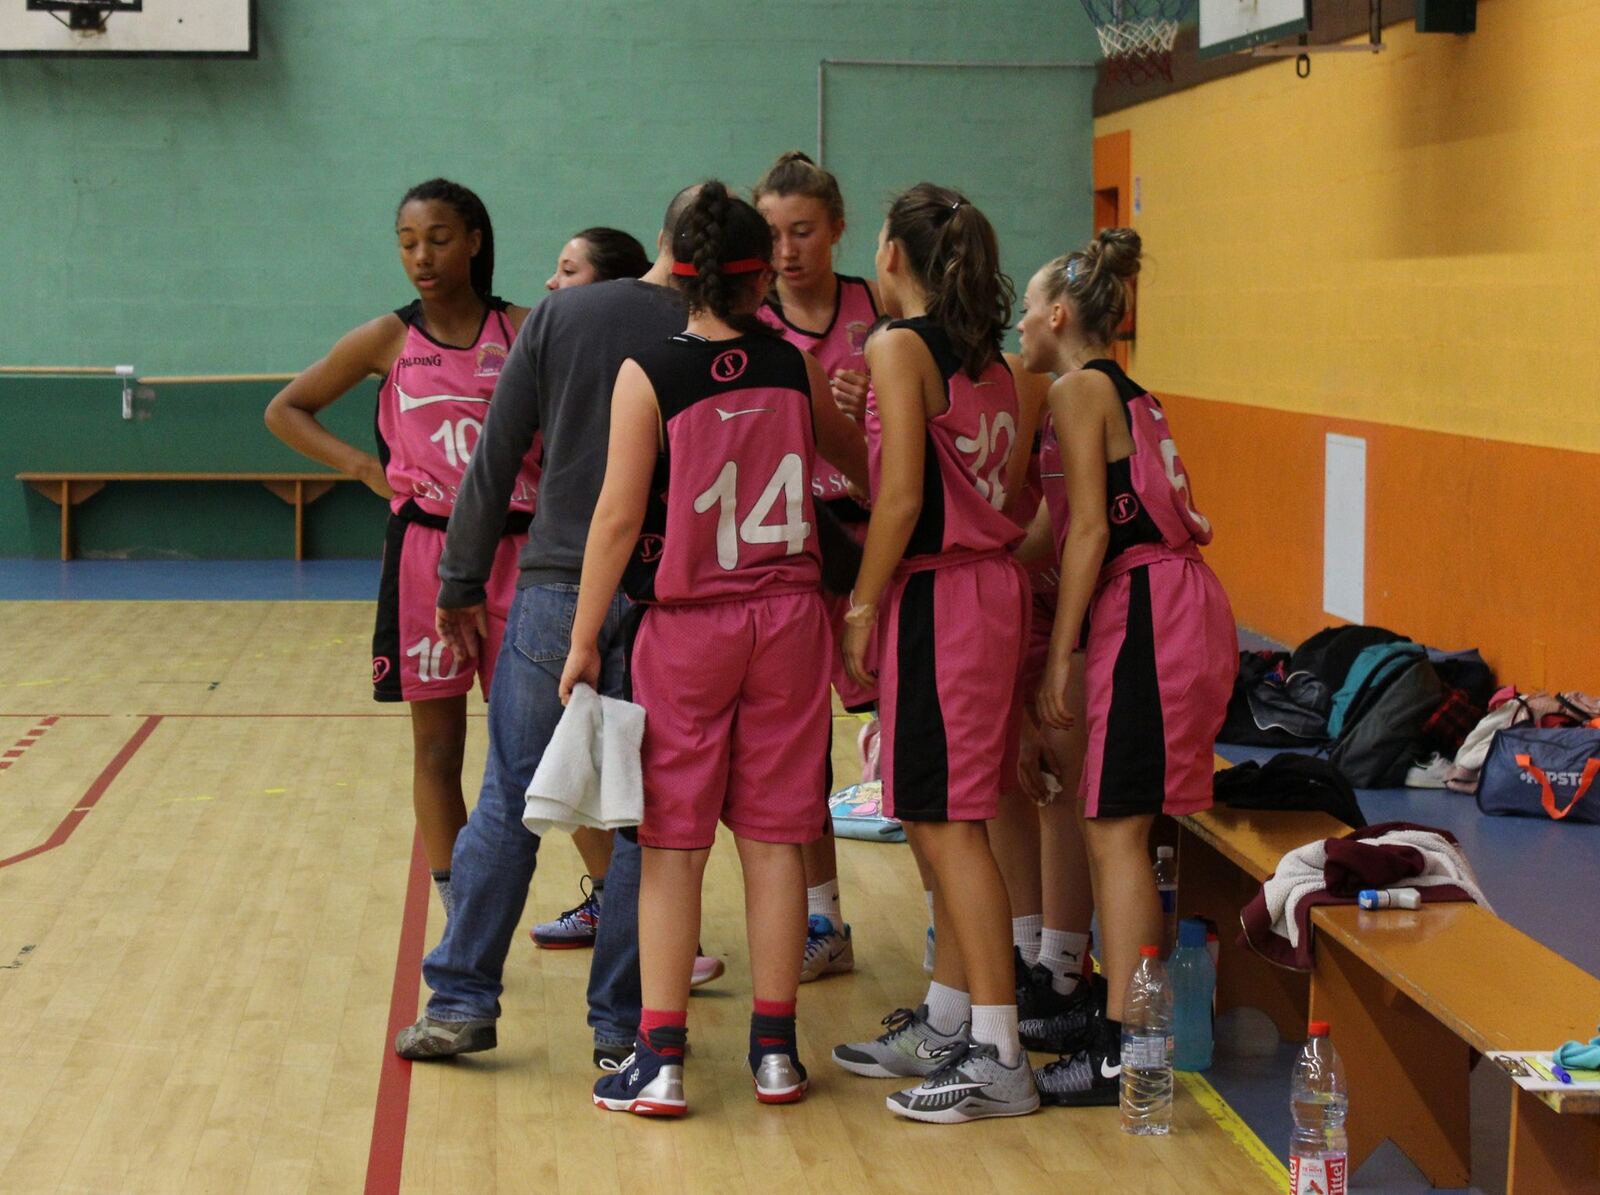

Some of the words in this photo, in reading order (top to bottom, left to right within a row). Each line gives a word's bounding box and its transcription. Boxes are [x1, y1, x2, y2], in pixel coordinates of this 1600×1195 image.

[399, 353, 442, 368] PALDING
[430, 417, 484, 468] 10
[694, 453, 811, 571] 14
[406, 636, 459, 683] 10
[1526, 771, 1583, 786] KPST
[1329, 1161, 1344, 1195] ittel
